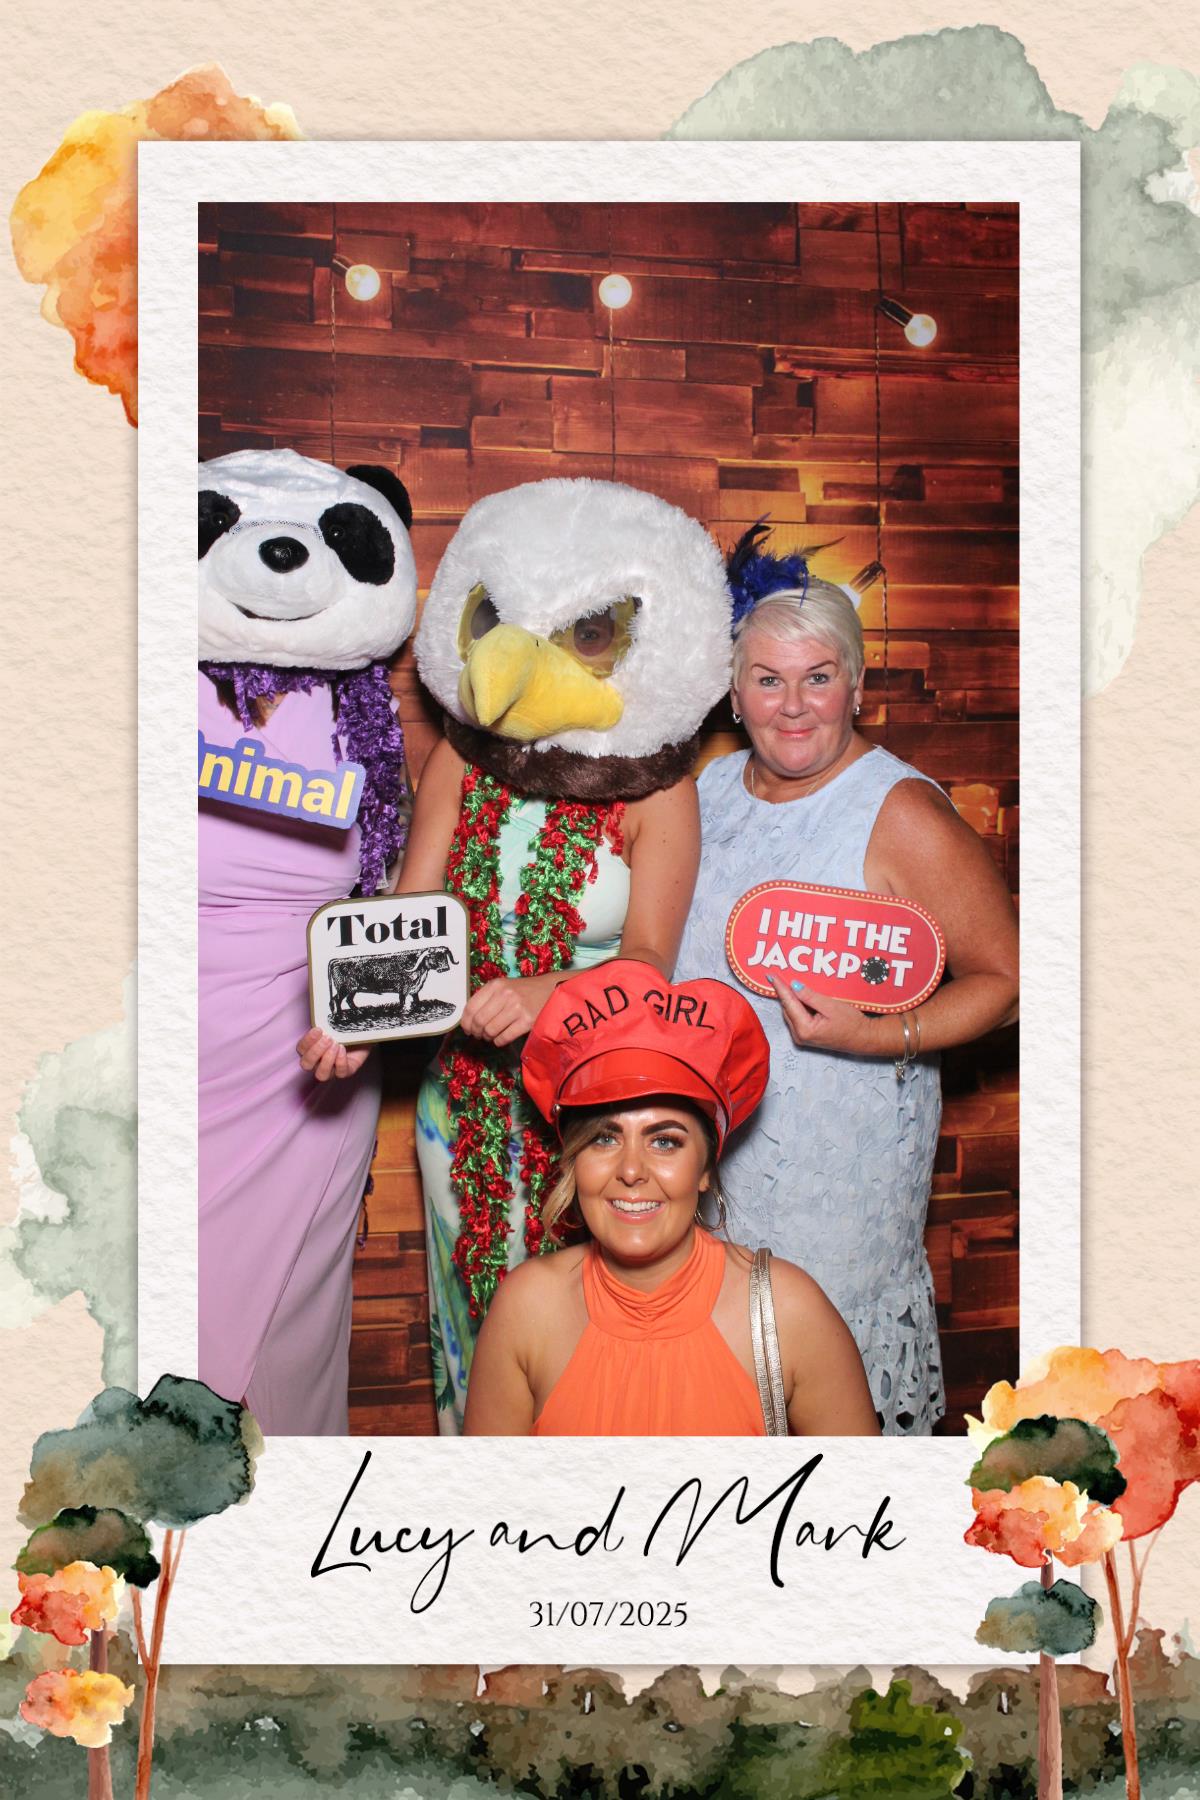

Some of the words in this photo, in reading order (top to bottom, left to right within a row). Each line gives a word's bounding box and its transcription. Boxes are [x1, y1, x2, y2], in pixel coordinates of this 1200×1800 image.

[198, 747, 356, 820] nimal
[327, 905, 449, 947] Total
[758, 907, 773, 936] I
[776, 909, 837, 943] HIT
[843, 919, 912, 955] THE
[562, 984, 631, 1038] BAD
[642, 988, 716, 1031] GIRL
